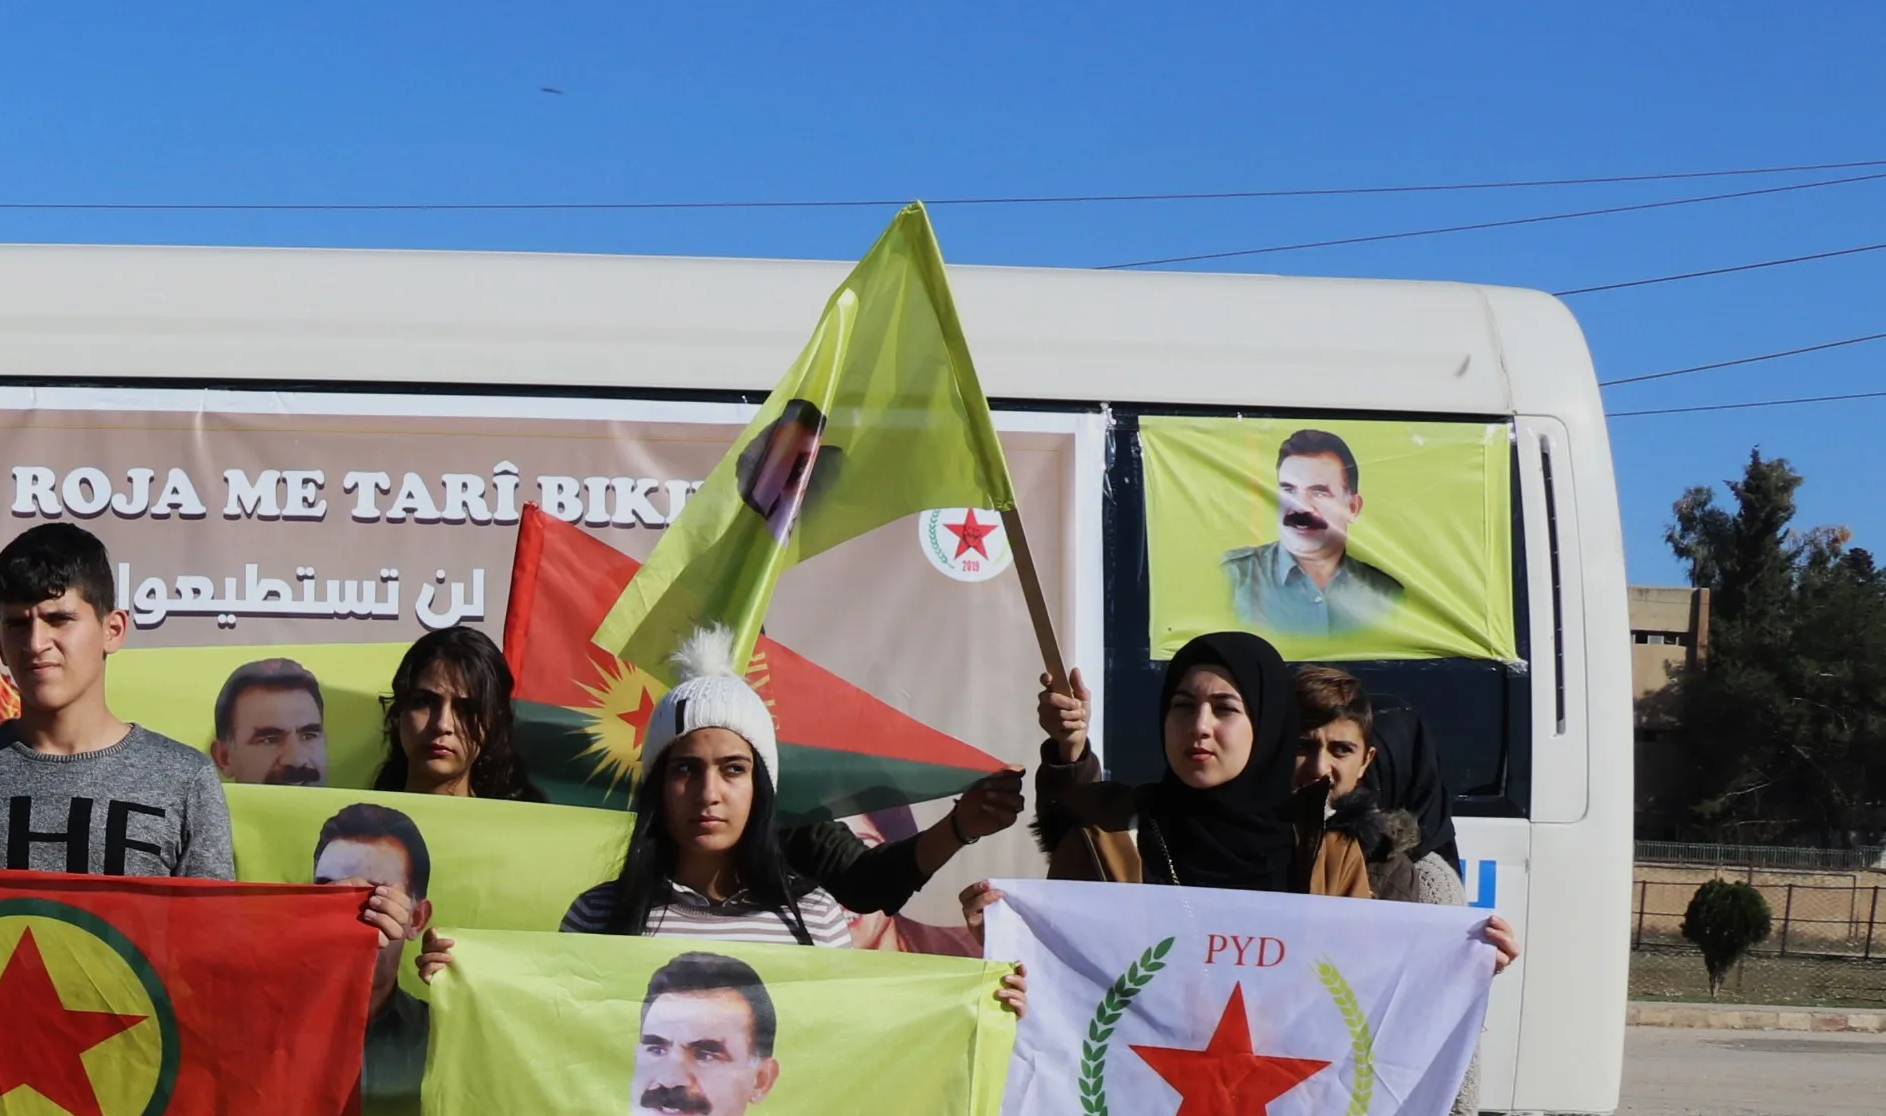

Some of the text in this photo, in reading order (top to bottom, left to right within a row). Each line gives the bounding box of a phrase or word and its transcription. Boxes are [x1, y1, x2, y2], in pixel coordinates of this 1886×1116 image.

[11, 466, 206, 518] ROJA
[224, 469, 327, 520] ME
[344, 461, 520, 524] TARÎ
[536, 475, 705, 528] BIKI
[118, 562, 400, 628] تستطيعوا
[415, 568, 485, 628] لن
[1204, 933, 1287, 969] PYD
